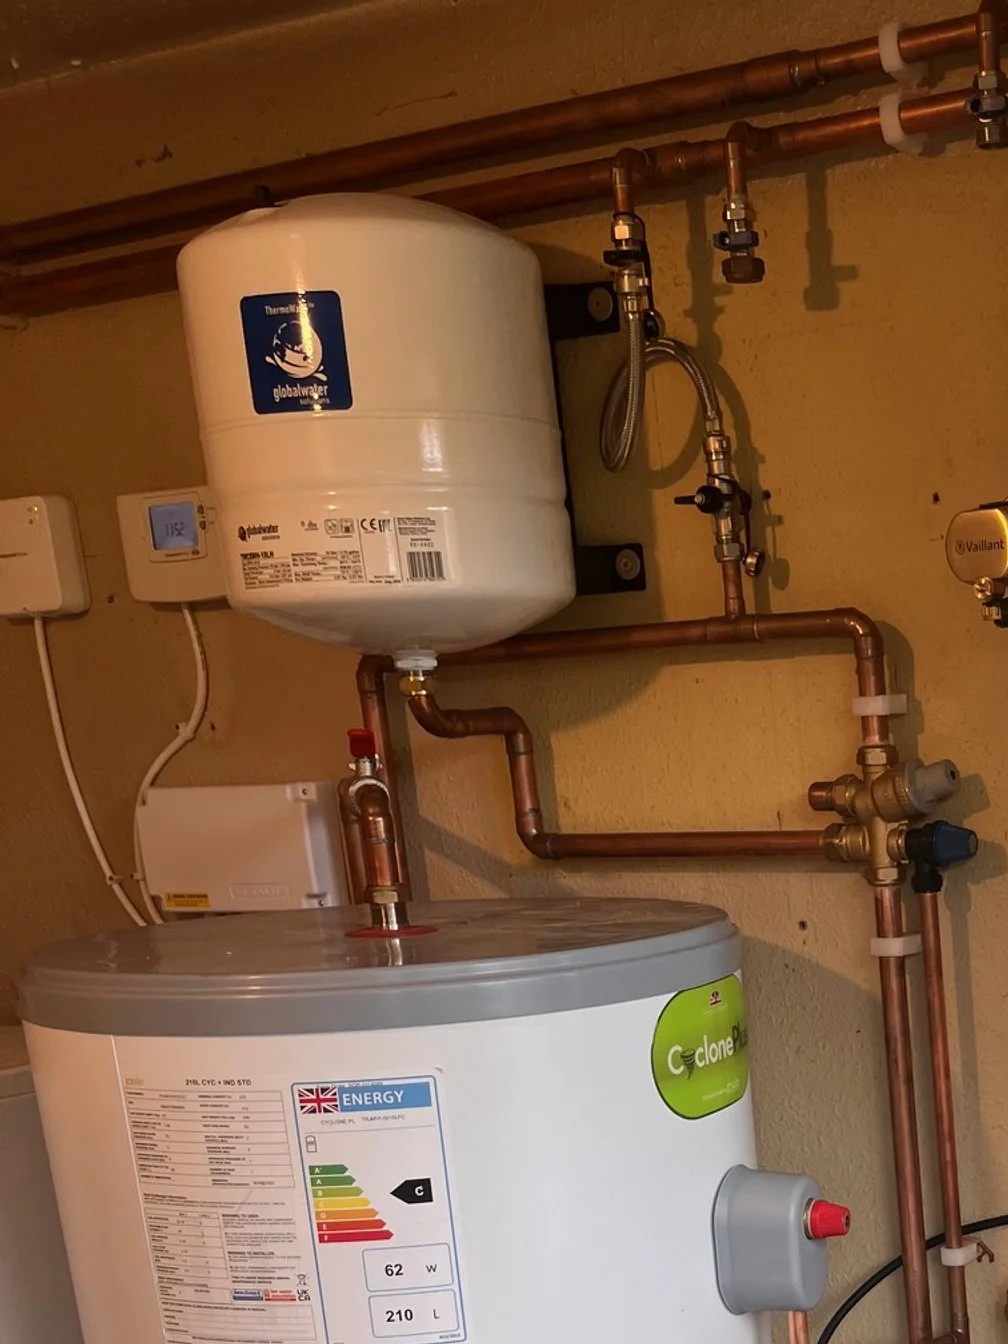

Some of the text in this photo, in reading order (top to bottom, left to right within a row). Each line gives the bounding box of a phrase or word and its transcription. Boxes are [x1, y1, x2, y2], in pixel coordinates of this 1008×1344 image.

[264, 303, 309, 315] ThermoWa
[273, 383, 329, 402] globalwater
[965, 539, 1005, 553] Vaillant
[342, 1090, 404, 1106] ENERGY
[415, 1185, 425, 1196] C
[384, 1263, 438, 1277] 62 W
[385, 1308, 440, 1323] 210 L
